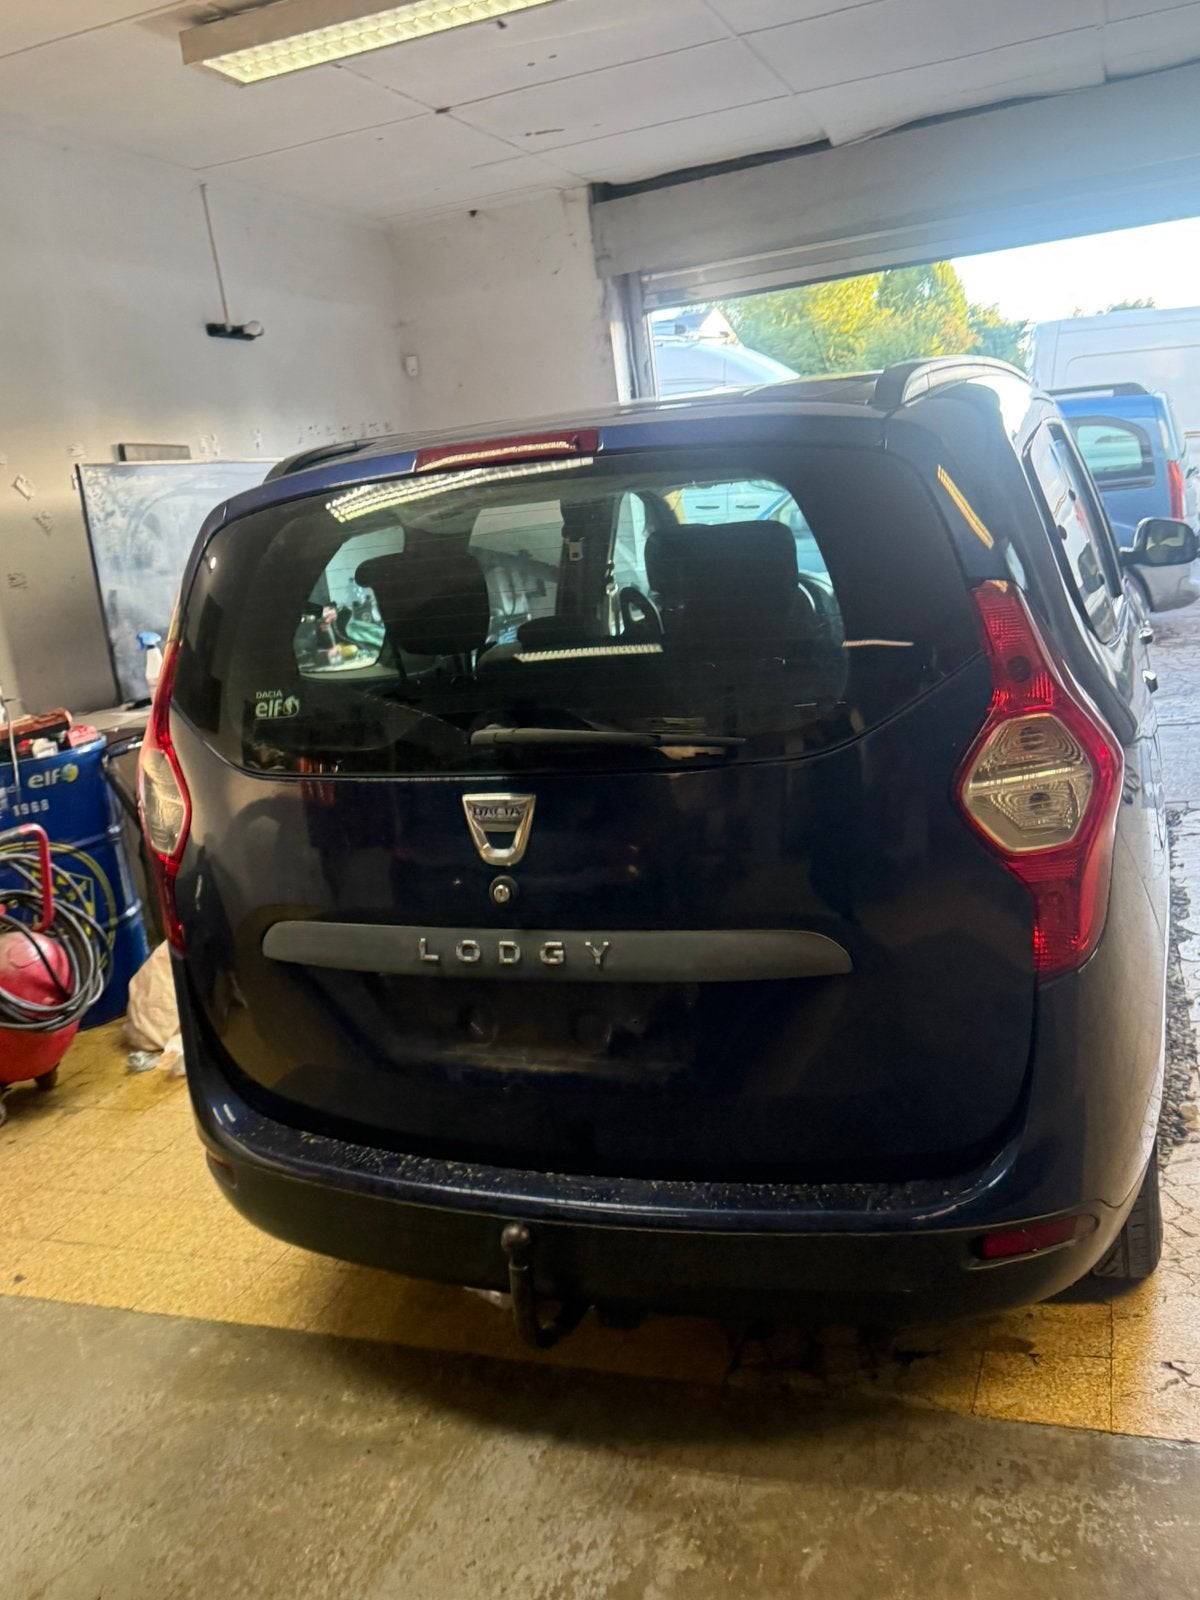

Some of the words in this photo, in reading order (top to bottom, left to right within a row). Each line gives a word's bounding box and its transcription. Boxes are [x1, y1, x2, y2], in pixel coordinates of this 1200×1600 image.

[255, 690, 283, 699] DACIA
[255, 699, 283, 718] elf
[28, 768, 61, 789] elf
[473, 806, 521, 816] DACIA
[418, 937, 610, 966] LODGY
